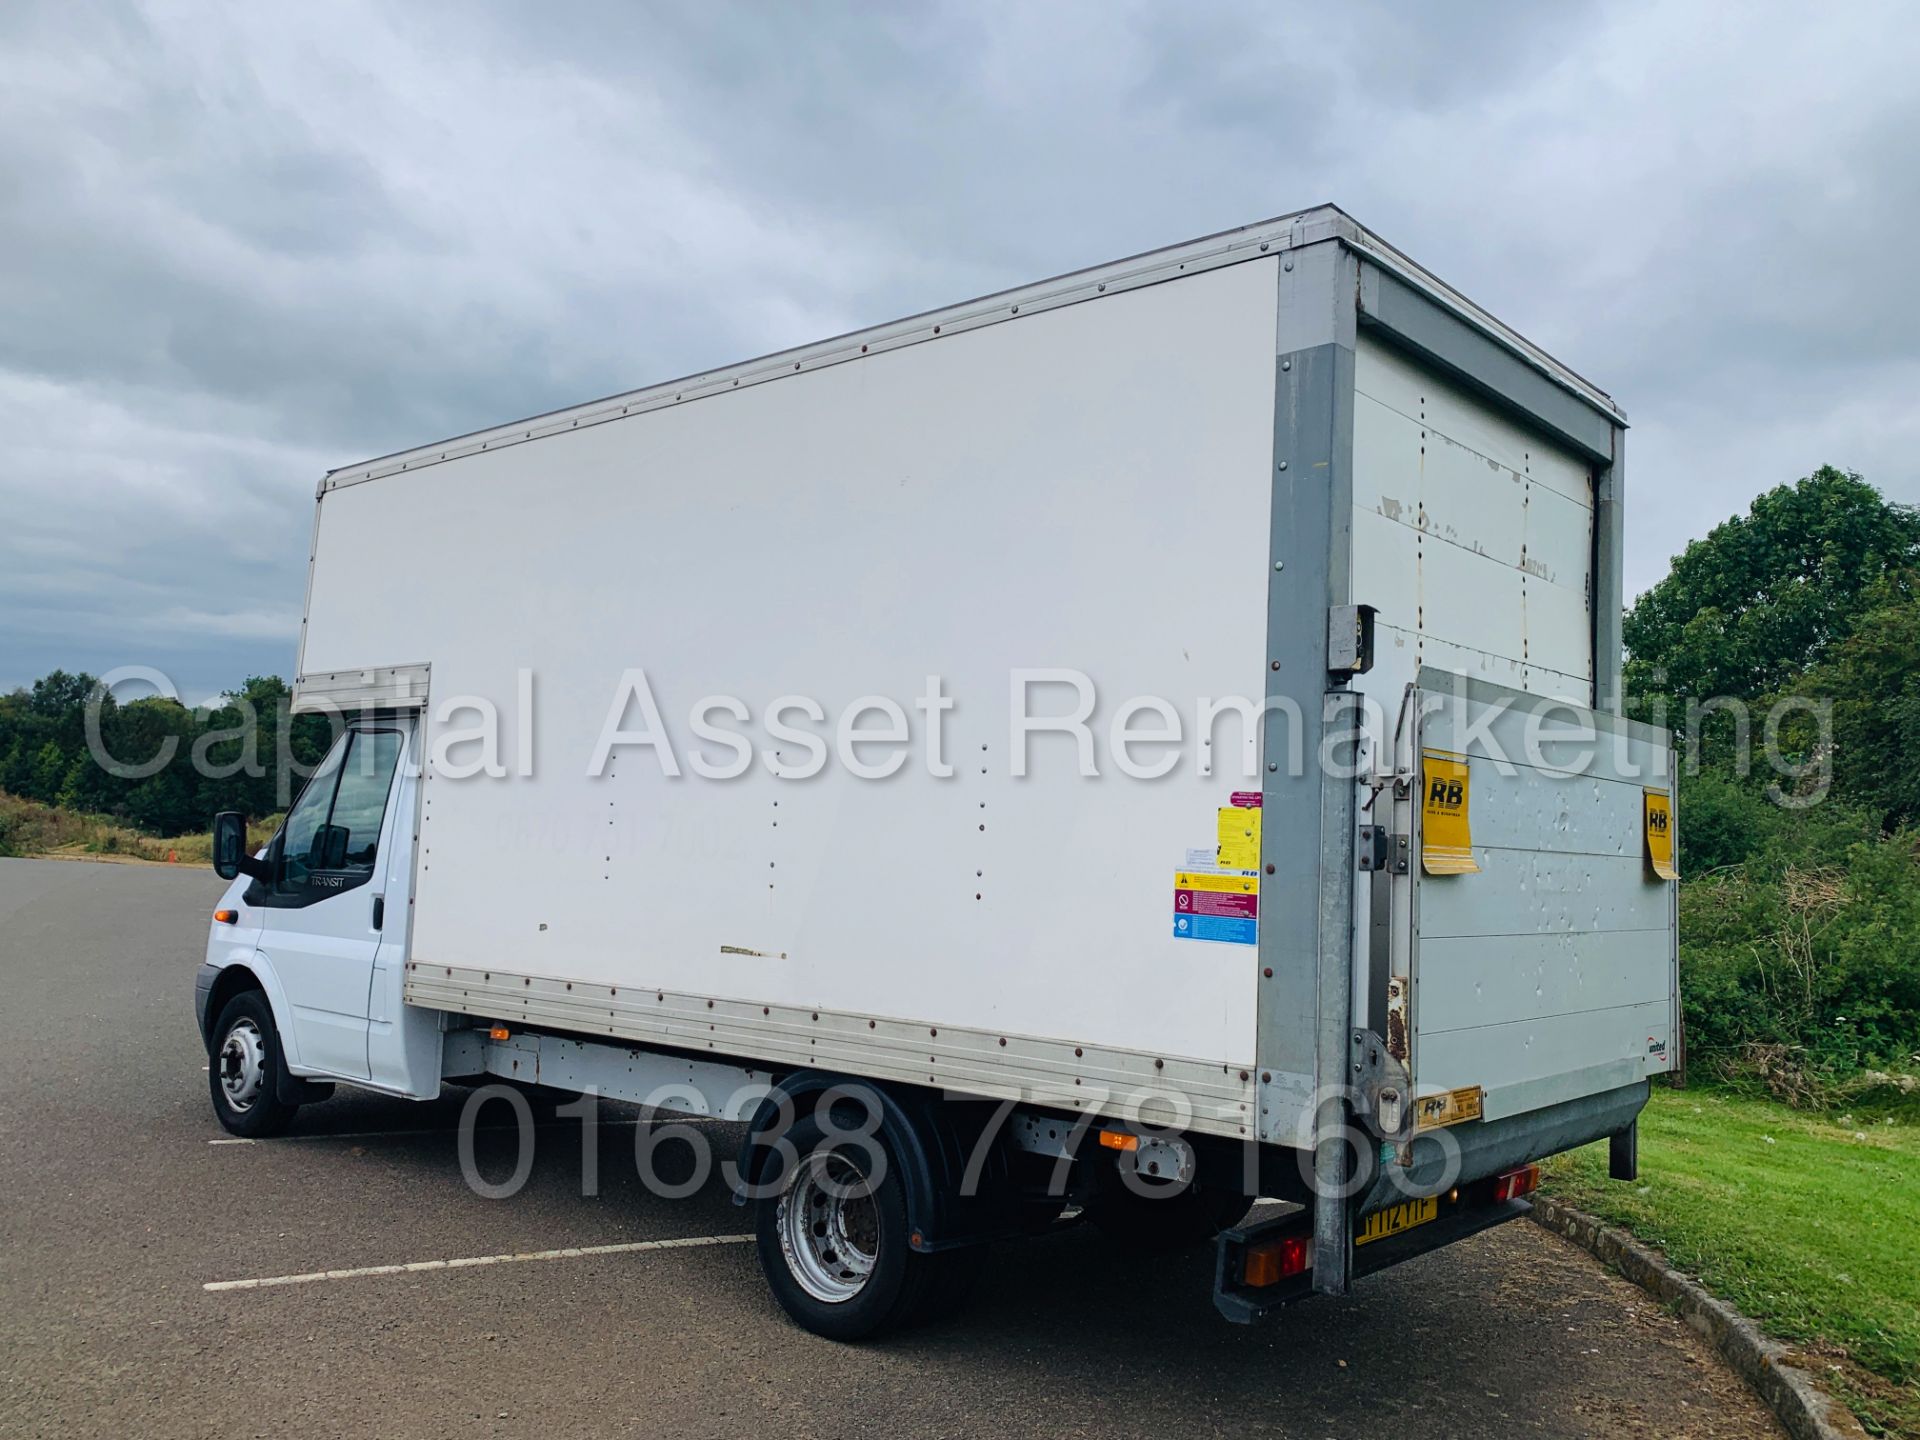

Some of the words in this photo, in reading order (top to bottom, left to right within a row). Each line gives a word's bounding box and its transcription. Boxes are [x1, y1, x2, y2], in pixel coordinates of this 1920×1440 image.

[1429, 777, 1463, 809] RB
[1649, 808, 1667, 832] RB
[312, 876, 344, 887] TRANSIT
